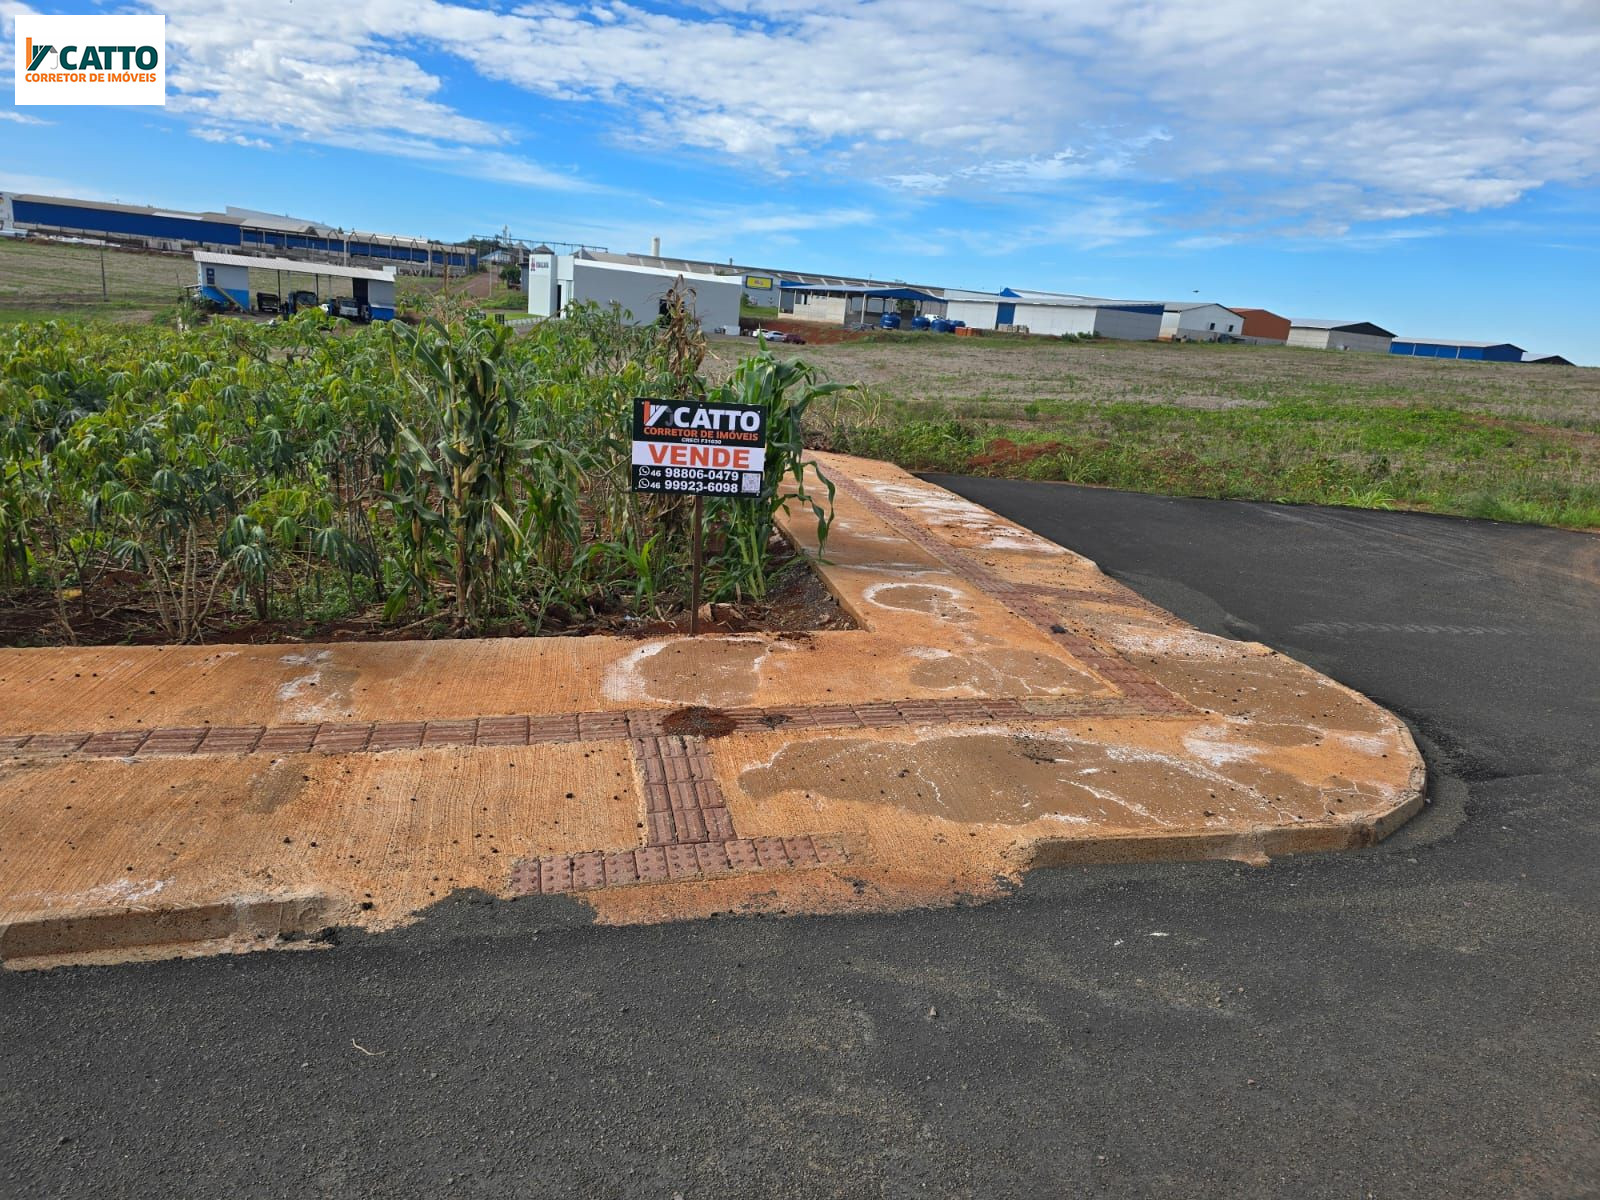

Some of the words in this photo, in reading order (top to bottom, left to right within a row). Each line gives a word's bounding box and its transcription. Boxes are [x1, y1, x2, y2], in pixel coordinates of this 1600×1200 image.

[674, 407, 760, 431] CATTO
[643, 427, 698, 438] CORRETOR
[700, 431, 714, 439] DE
[716, 430, 759, 441] IMÓVEIS
[648, 444, 750, 469] VENDE
[650, 469, 661, 477] 46
[665, 467, 738, 481] 98806-0479
[664, 480, 738, 493] 99923-6098
